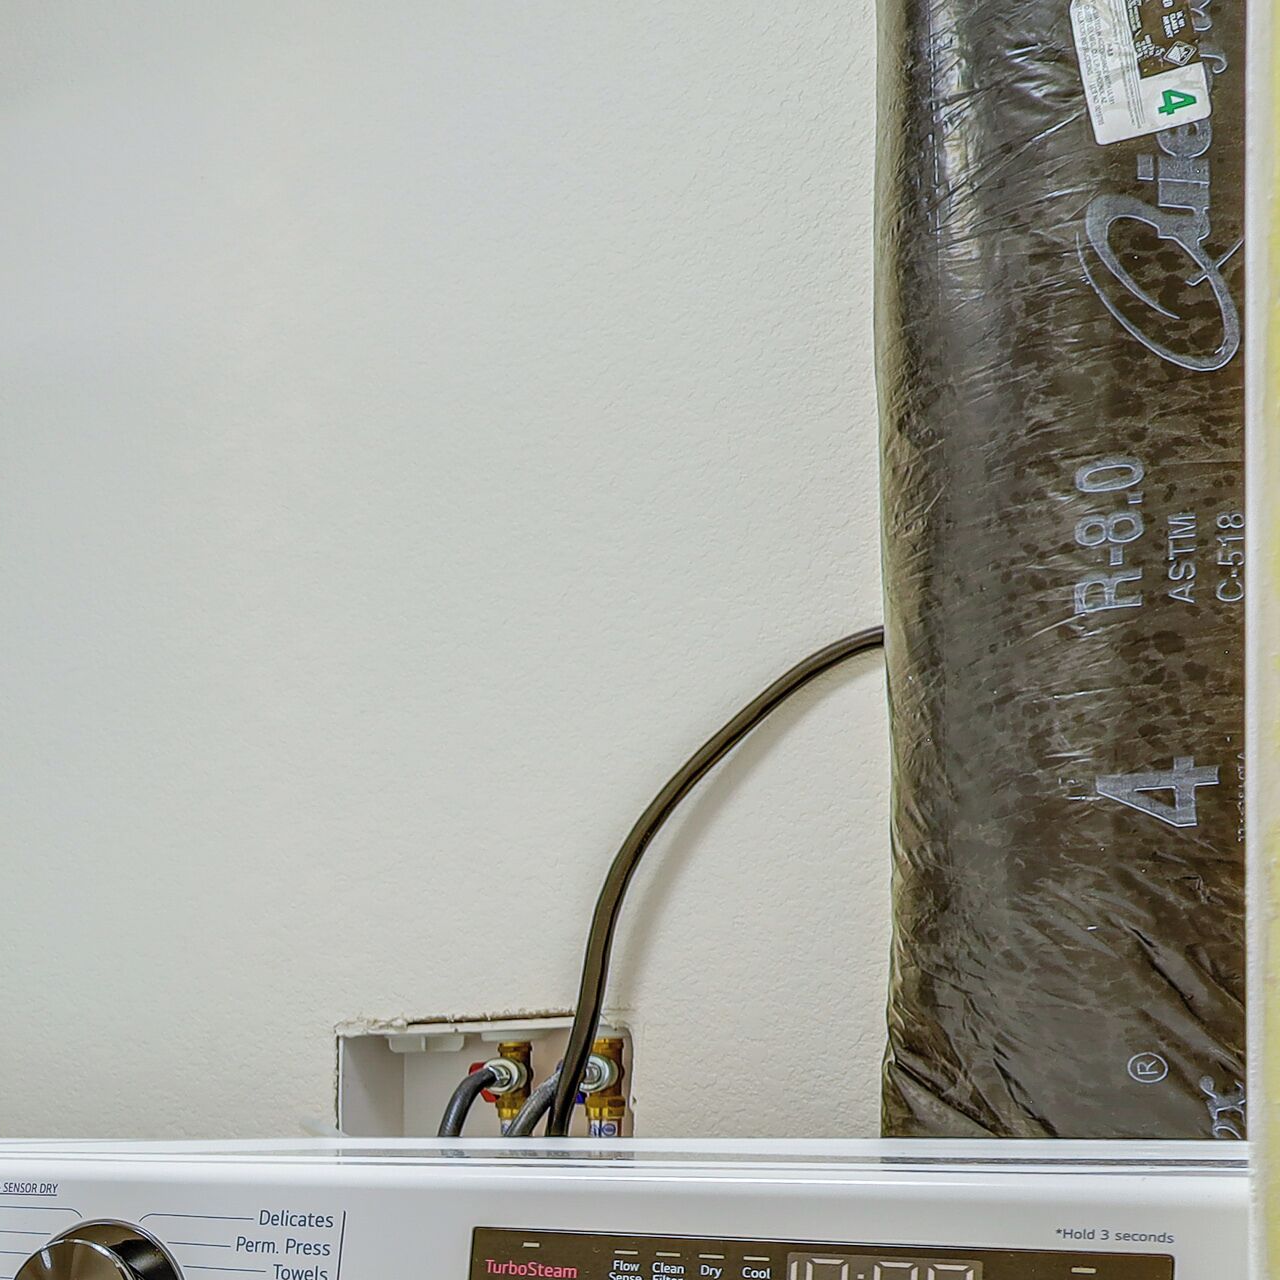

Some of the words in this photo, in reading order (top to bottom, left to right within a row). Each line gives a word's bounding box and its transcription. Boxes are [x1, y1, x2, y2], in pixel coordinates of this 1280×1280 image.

[1157, 89, 1197, 115] 4
[1074, 456, 1144, 614] R-8.0
[1168, 512, 1196, 604] ASTM
[1216, 512, 1244, 602] C-518
[1095, 756, 1220, 827] 4
[3, 1182, 38, 1193] SENSOR
[39, 1183, 58, 1194] DRY
[259, 1209, 334, 1228] Delicates
[235, 1236, 280, 1255] Perm.
[285, 1238, 331, 1257] Press
[1100, 1229, 1110, 1241] 3
[1115, 1231, 1175, 1244] seconds
[485, 1258, 578, 1279] TurboSteam
[613, 1259, 640, 1272] Flow
[652, 1262, 685, 1274] Clean
[700, 1264, 723, 1279] Dry
[742, 1266, 771, 1280] Cool
